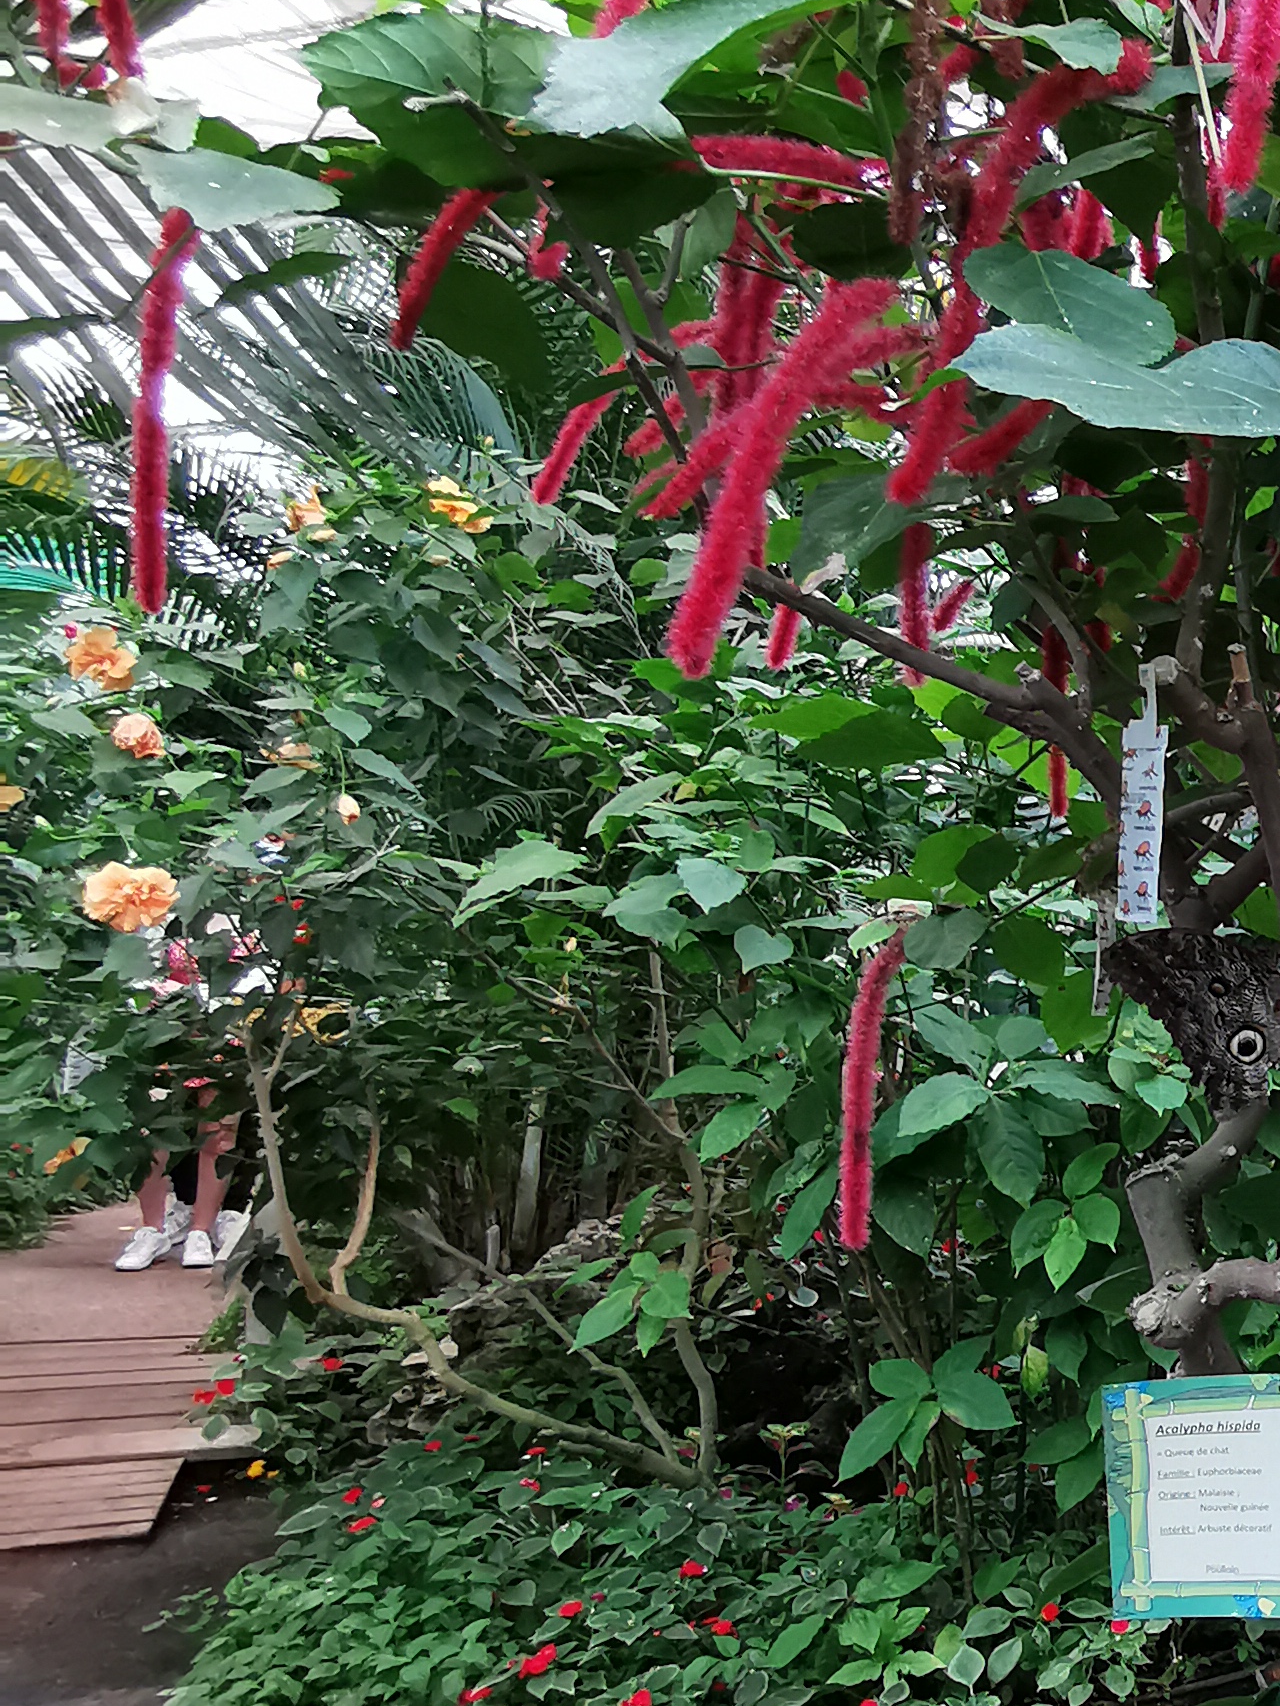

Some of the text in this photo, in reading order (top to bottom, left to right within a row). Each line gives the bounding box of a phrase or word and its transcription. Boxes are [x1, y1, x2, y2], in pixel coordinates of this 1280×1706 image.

[1156, 1420, 1261, 1436] Acalypha hispida
[1196, 1447, 1209, 1455] de
[1210, 1446, 1229, 1455] chat
[1198, 1524, 1231, 1533] Arbuste
[1234, 1524, 1272, 1533] décoratif
